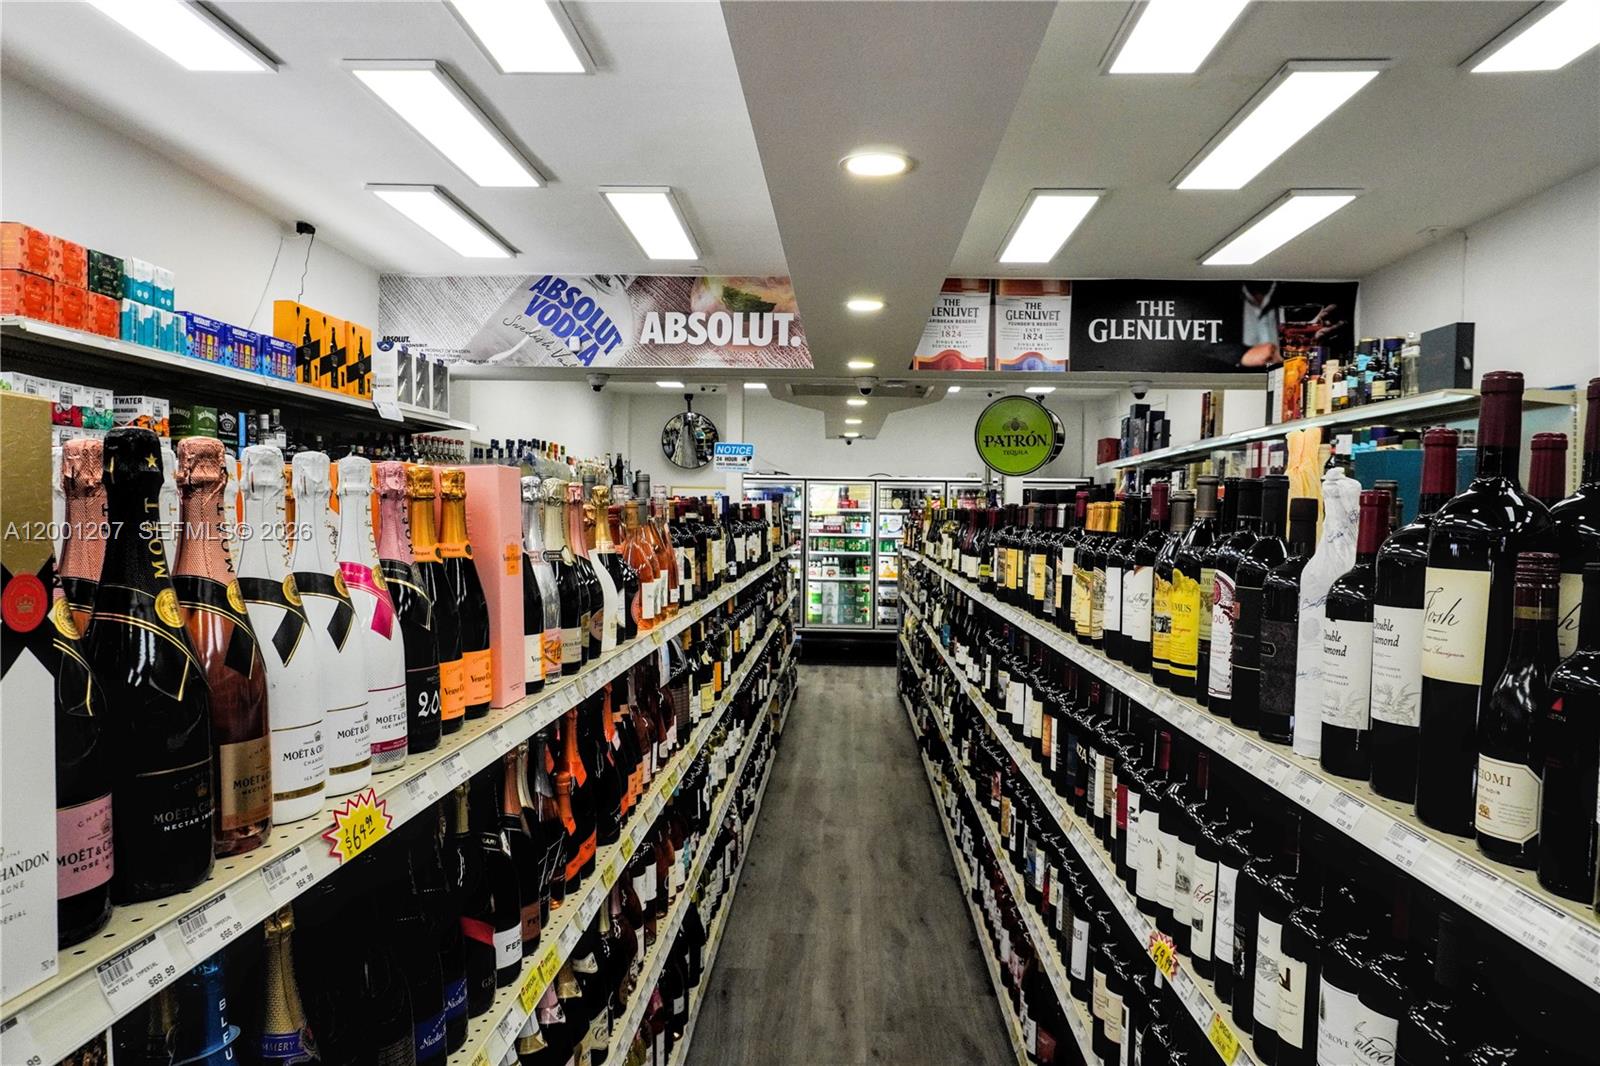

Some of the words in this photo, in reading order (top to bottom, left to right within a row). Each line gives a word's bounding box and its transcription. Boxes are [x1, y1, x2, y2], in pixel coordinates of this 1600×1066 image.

[943, 299, 960, 307] THE
[1025, 302, 1042, 310] THE
[1136, 299, 1175, 318] THE
[529, 275, 623, 356] ABSOLUT
[931, 307, 979, 318] LENLIVET
[1005, 309, 1061, 321] GLENLIVET
[941, 330, 962, 338] 1824
[1022, 333, 1043, 341] 1824
[716, 445, 752, 455] NOTICE
[163, 816, 200, 832] NECTAR
[0, 850, 50, 881] HANDON
[148, 964, 176, 988] $69.99
